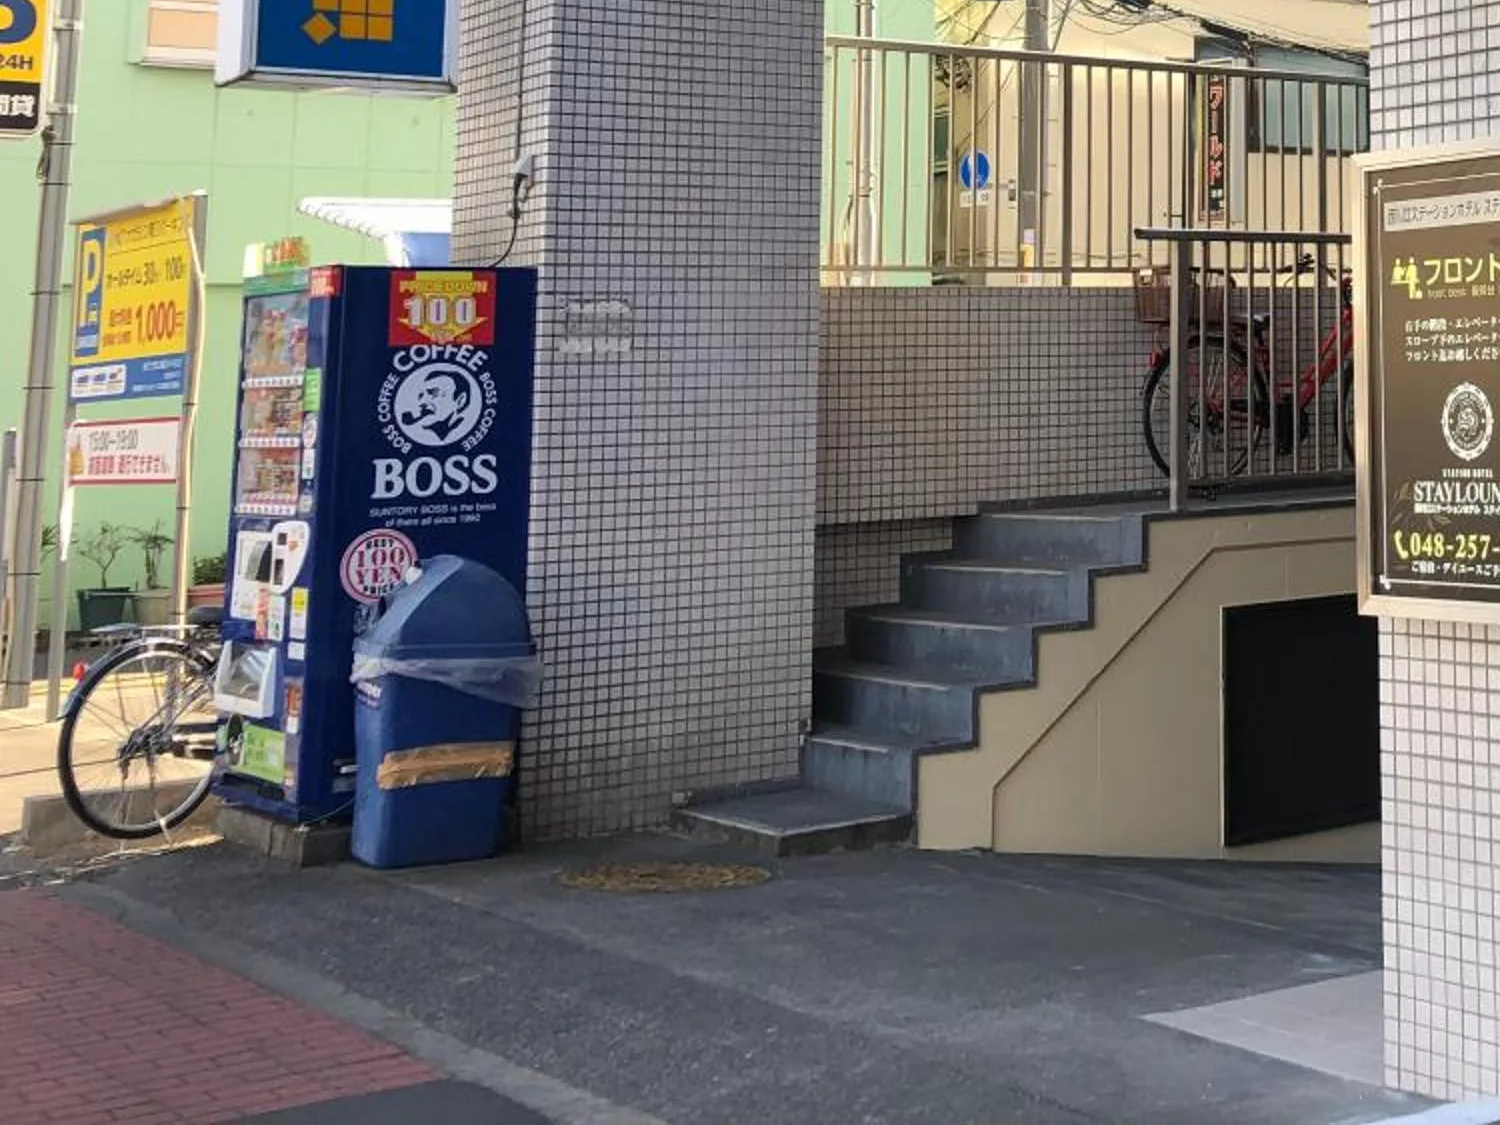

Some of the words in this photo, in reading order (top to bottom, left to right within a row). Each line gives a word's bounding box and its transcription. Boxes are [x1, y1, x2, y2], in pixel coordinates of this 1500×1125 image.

[1387, 201, 1480, 226] 西口ステーションホテル
[403, 295, 477, 326] 100
[392, 343, 489, 373] COFFEE
[377, 373, 399, 423] COFFEE
[479, 372, 499, 405] BOSS
[381, 424, 413, 454] BOSS
[460, 408, 497, 452] COFFEE
[370, 453, 499, 500] BOSS
[357, 547, 405, 568] 100
